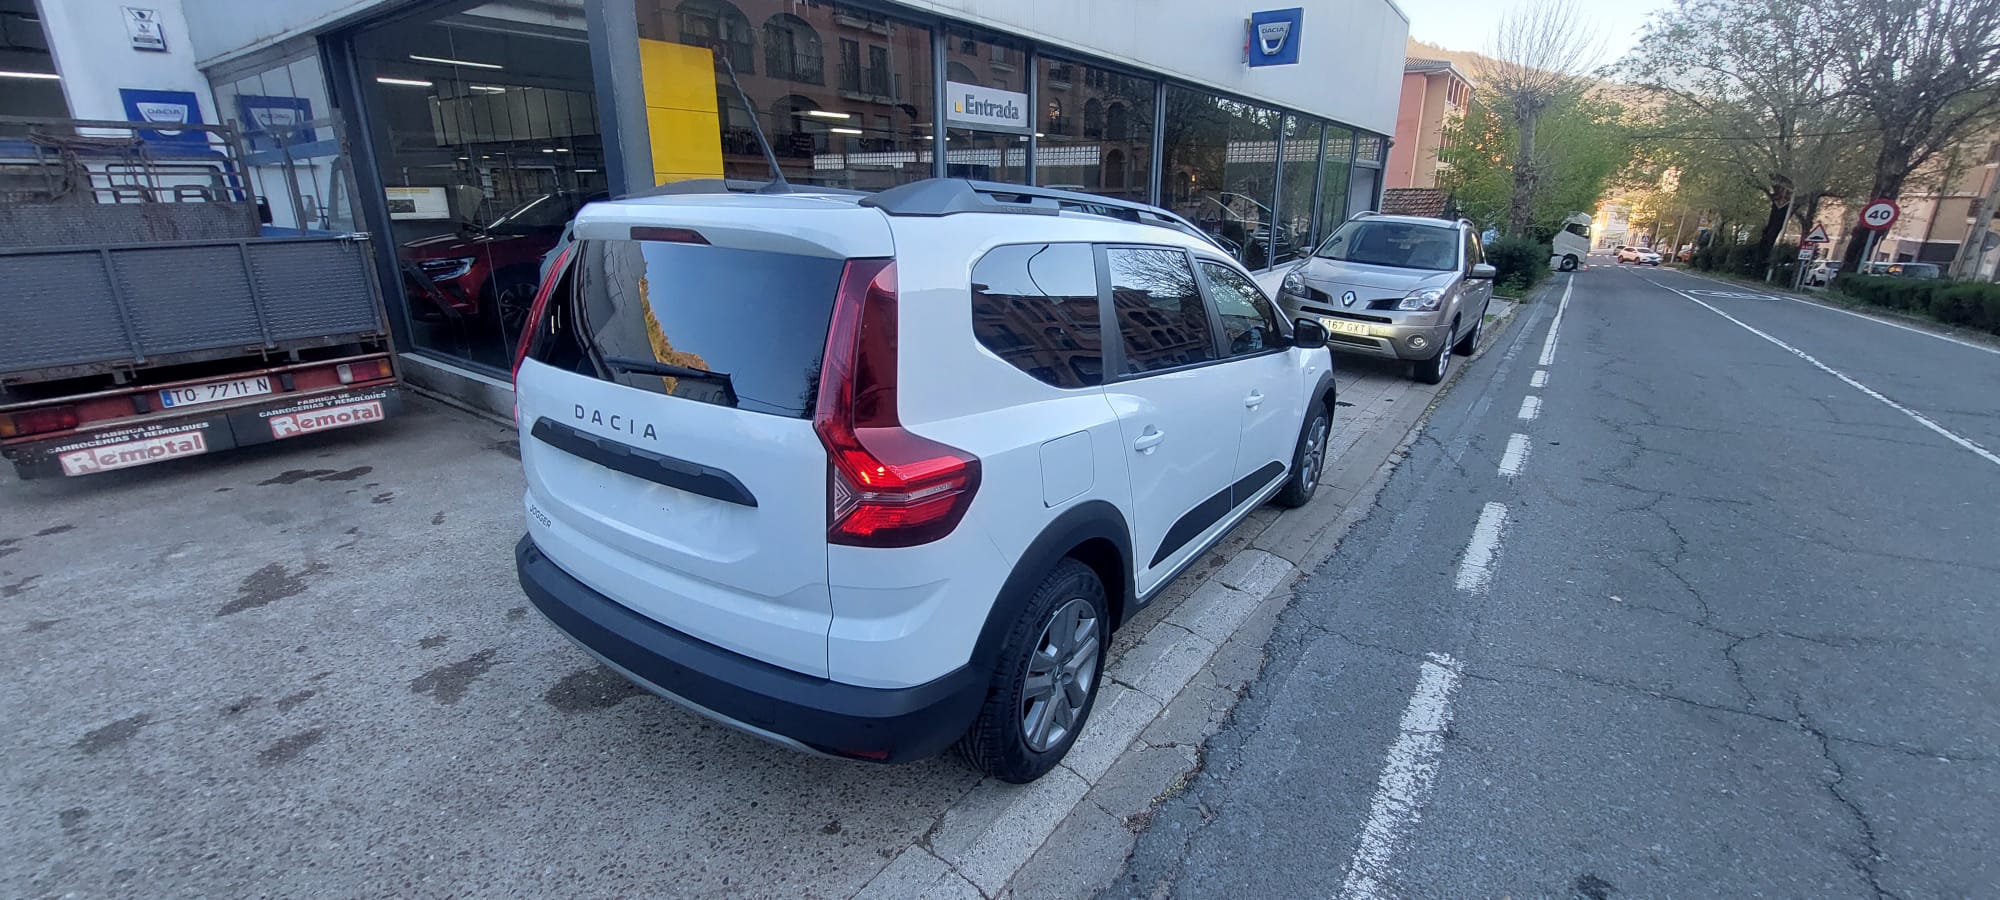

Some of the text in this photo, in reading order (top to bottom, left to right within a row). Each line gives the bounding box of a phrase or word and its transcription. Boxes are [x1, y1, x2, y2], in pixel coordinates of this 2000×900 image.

[147, 108, 181, 116] DACIA
[965, 94, 1019, 120] Entrada
[1868, 210, 1891, 220] 40
[1321, 319, 1345, 330] 167
[256, 378, 268, 391] N
[259, 402, 324, 418] CARROCERIAS
[335, 392, 387, 405] REMOLQUES
[297, 395, 336, 406] FABRICA
[271, 404, 380, 437] Remotal
[574, 404, 658, 441] DACIA
[94, 427, 145, 440] FABRICA
[144, 422, 210, 438] REMOLQUES
[62, 434, 203, 474] Remotal
[529, 504, 552, 529] JOGGER
